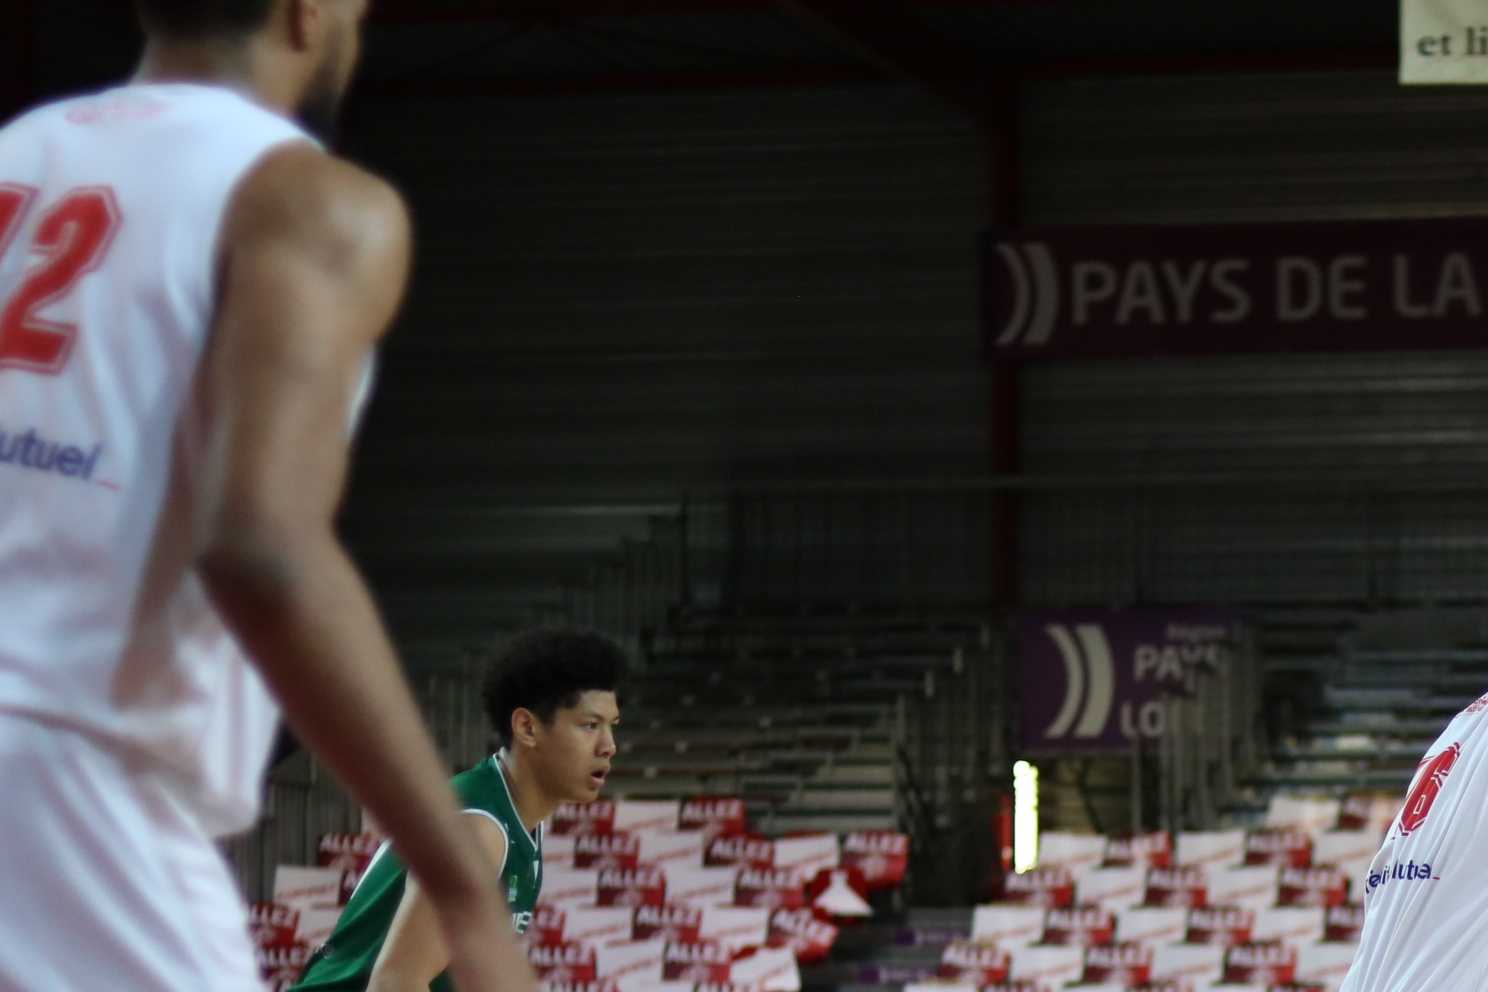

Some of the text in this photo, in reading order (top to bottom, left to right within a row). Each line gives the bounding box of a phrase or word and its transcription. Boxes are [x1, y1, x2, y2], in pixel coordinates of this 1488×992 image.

[1417, 28, 1452, 57] et
[1071, 259, 1252, 326] PAYS
[1275, 255, 1369, 322] DE
[1393, 251, 1483, 318] LA
